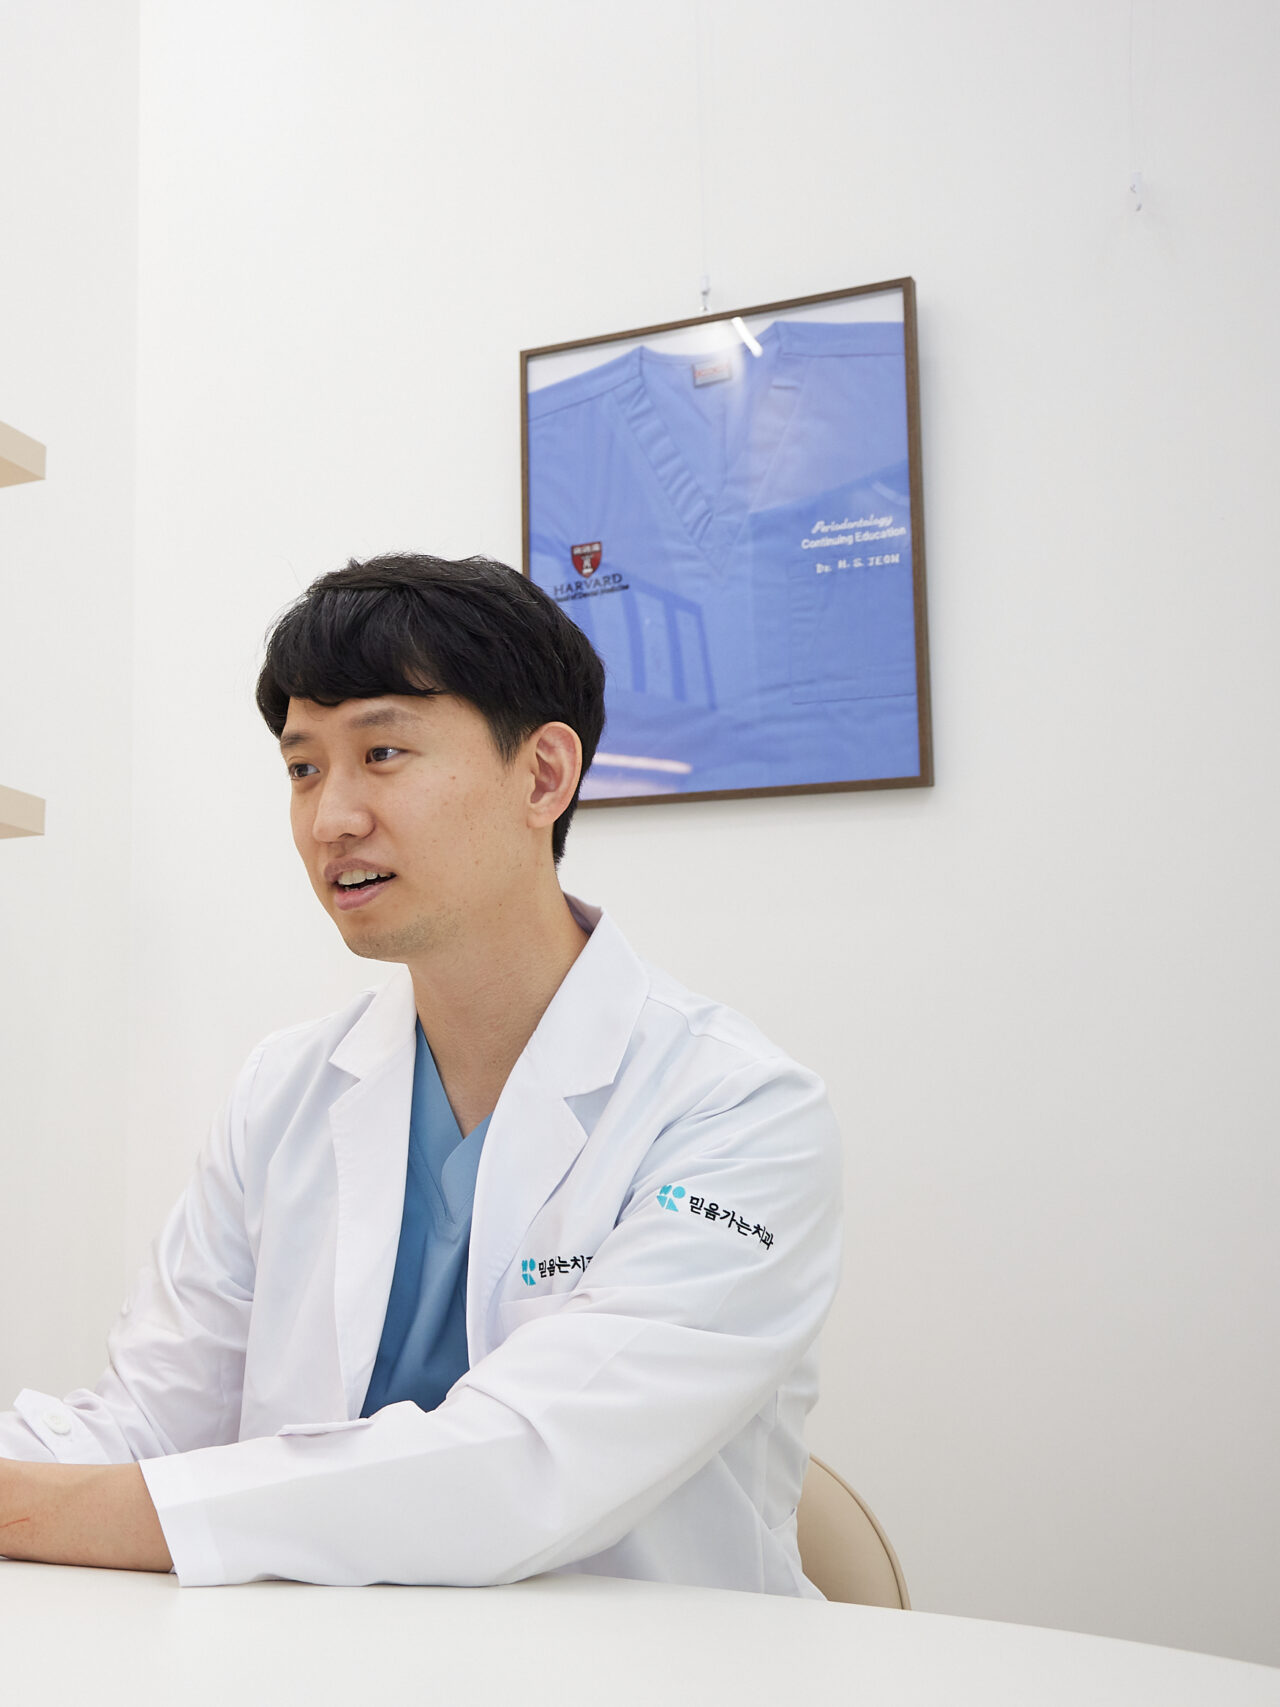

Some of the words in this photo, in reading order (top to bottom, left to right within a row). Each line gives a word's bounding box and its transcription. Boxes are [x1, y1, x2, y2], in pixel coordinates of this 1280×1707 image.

[811, 514, 893, 534] Periodontology
[801, 534, 854, 549] Continuing
[854, 526, 907, 543] Education
[554, 572, 623, 597] HARVARD
[689, 1195, 774, 1251] 믿음가는치과
